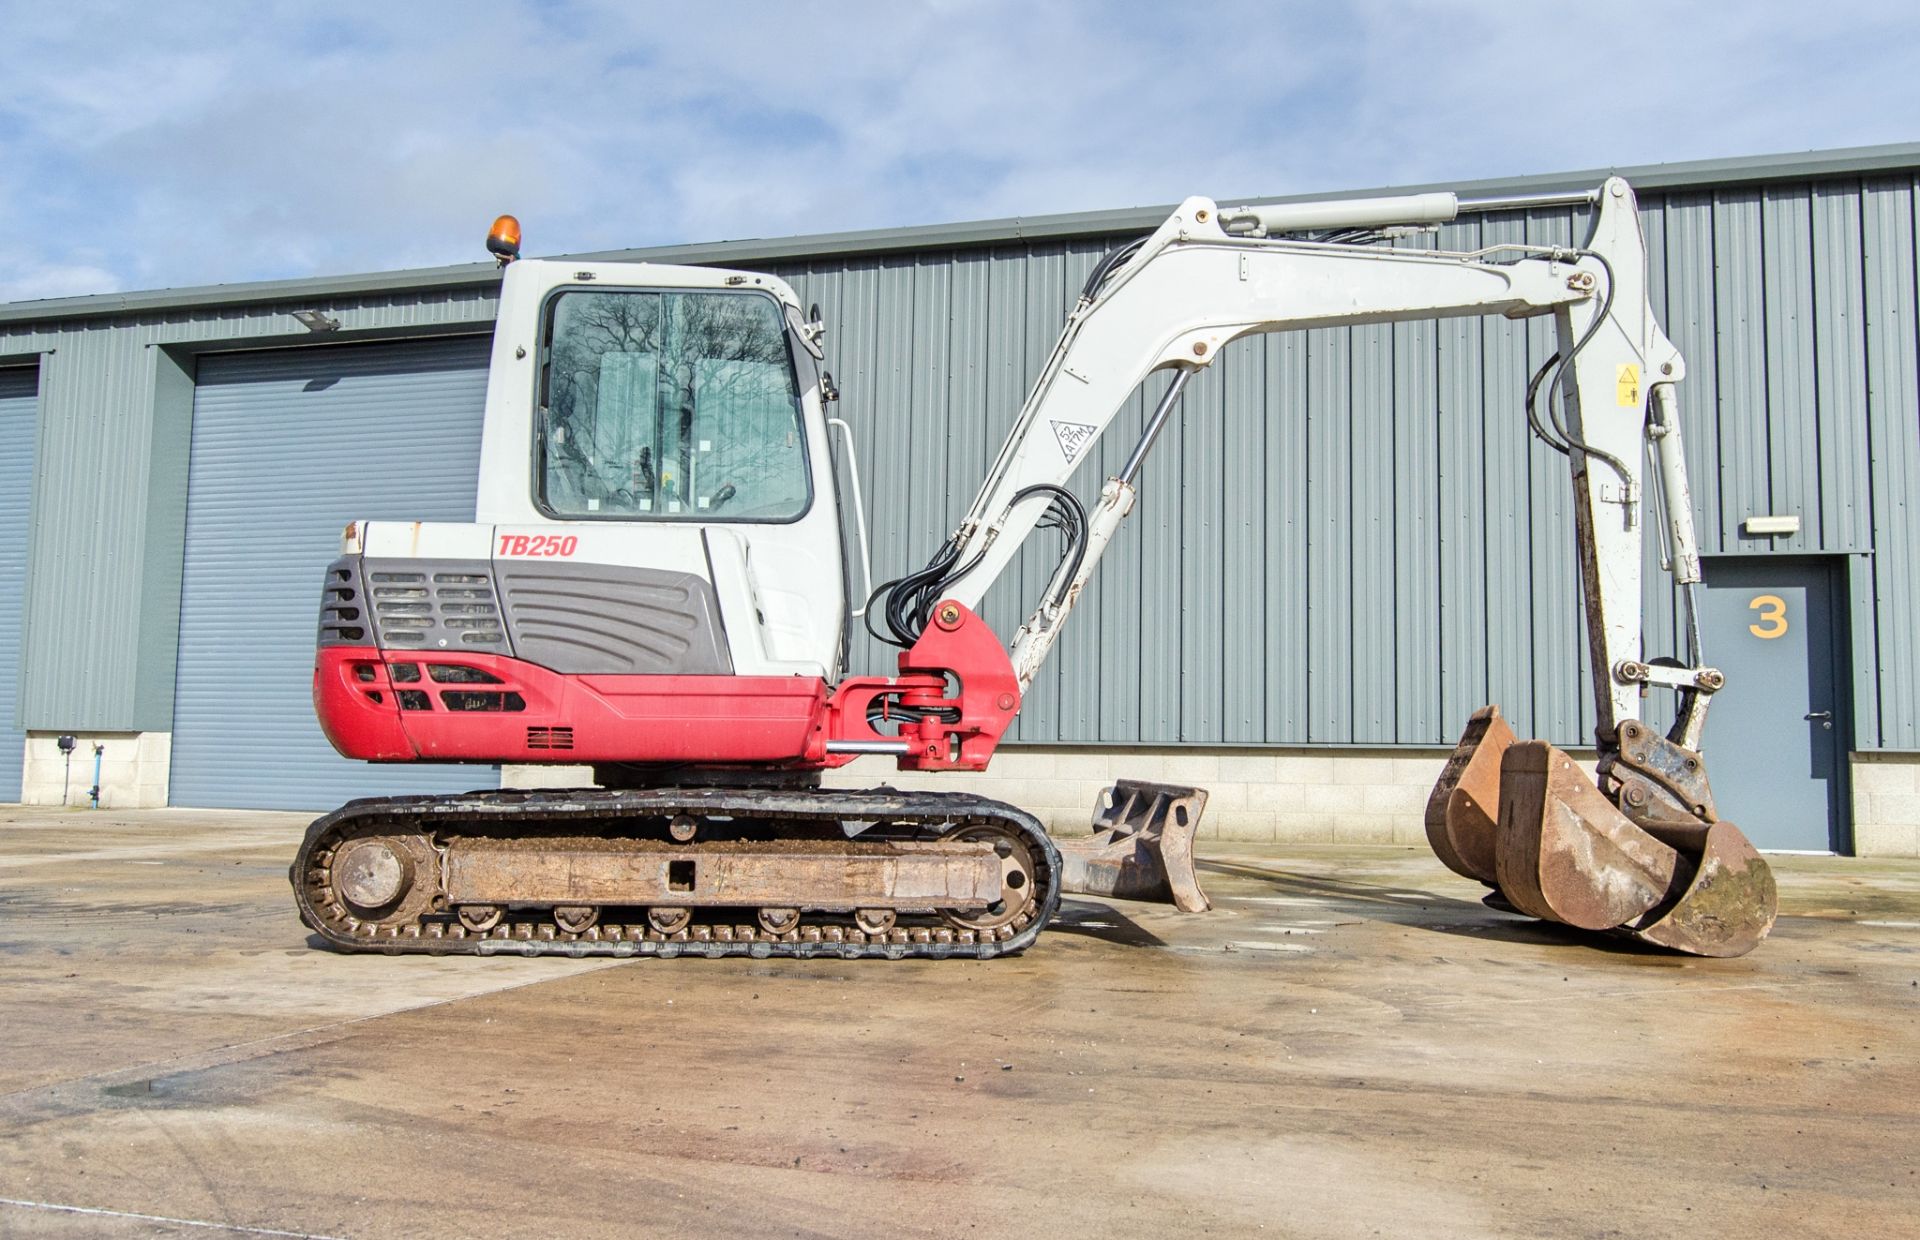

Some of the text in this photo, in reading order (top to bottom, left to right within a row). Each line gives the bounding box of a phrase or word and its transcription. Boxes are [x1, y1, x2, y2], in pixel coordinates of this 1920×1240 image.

[1060, 425, 1075, 441] 52
[499, 535, 578, 556] TB250
[1748, 594, 1788, 639] 3
